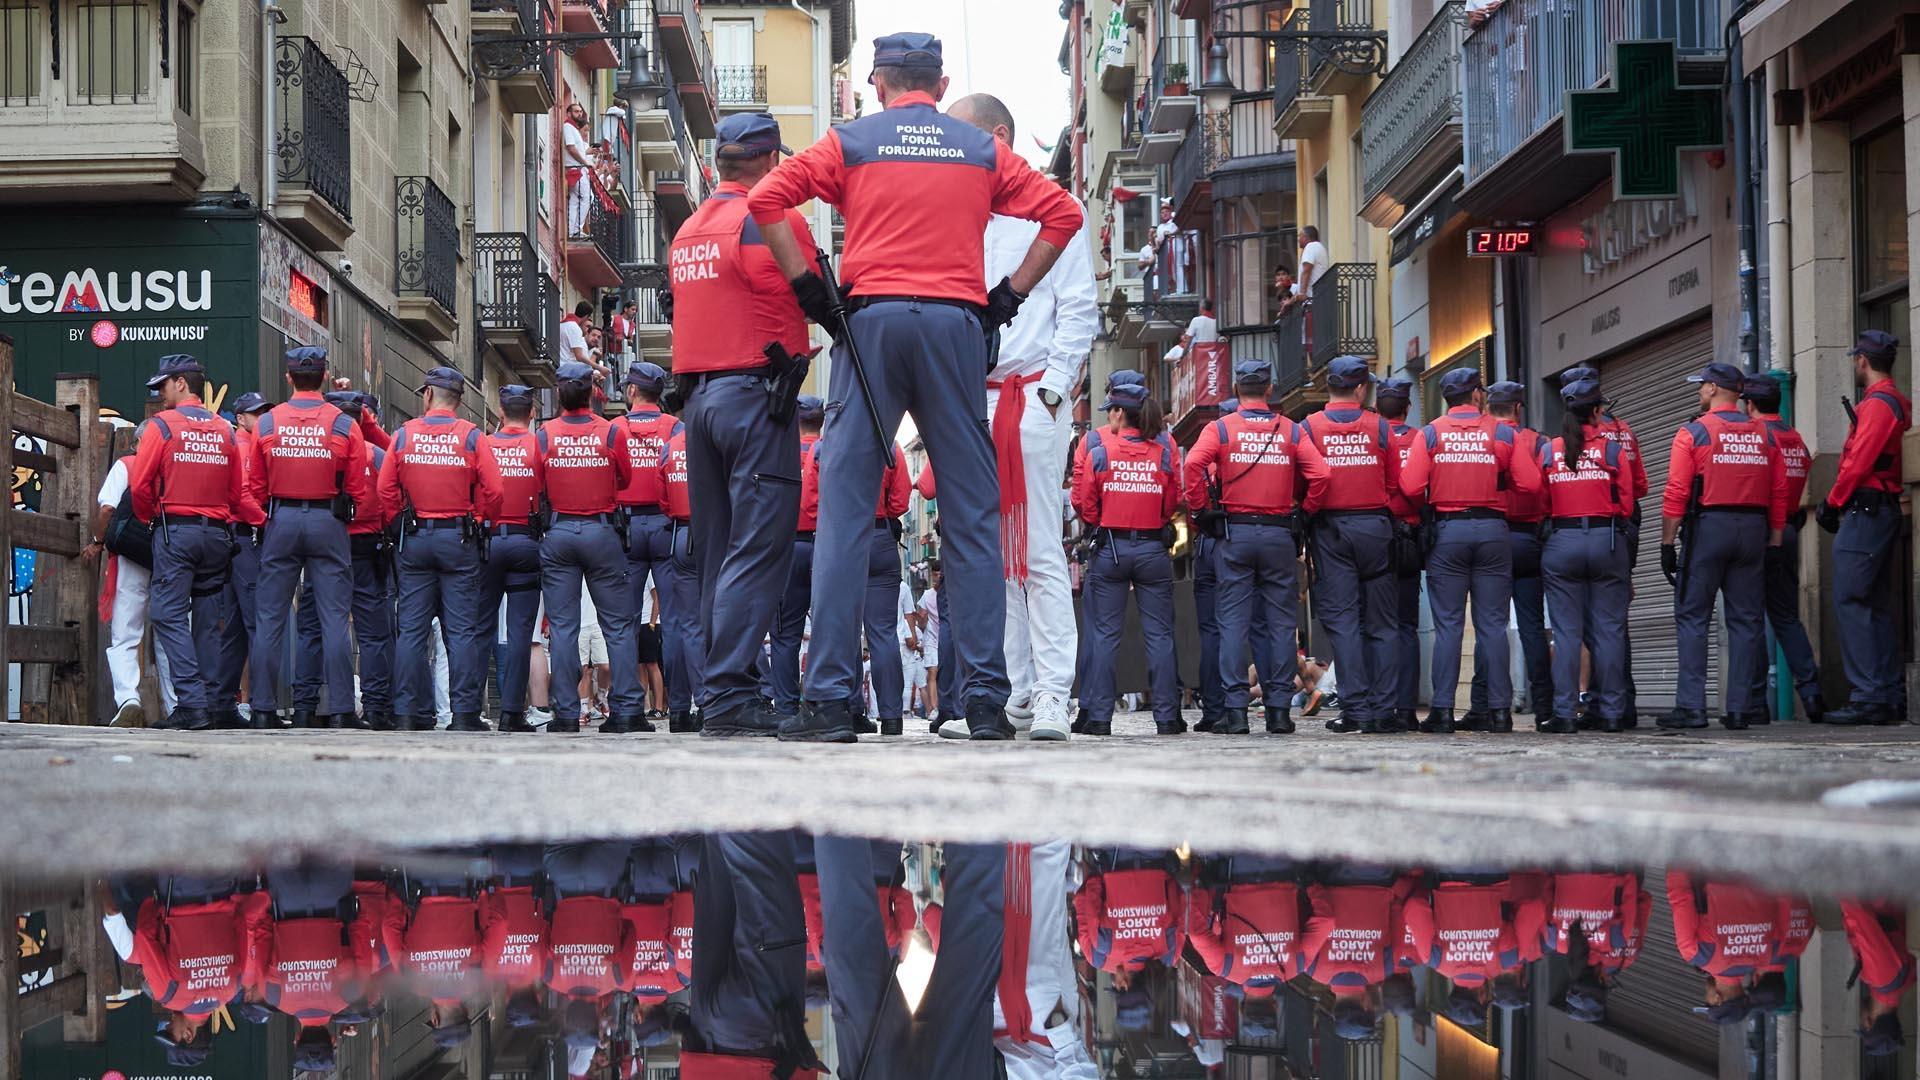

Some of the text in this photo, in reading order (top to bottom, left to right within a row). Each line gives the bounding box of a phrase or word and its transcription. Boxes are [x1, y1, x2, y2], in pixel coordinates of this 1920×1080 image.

[897, 124, 943, 135] POLICÍA
[901, 135, 941, 145] FORAL
[878, 145, 965, 158] FORUZAINGOA
[672, 240, 720, 264] POLICÍA
[673, 262, 719, 284] FORAL
[69, 328, 84, 341] BY
[1207, 359, 1217, 396] AMBAR
[181, 430, 224, 443] POLICÍA
[278, 425, 325, 437] POLICÍA
[1441, 429, 1489, 442] POLICÍA
[281, 436, 323, 447] FORAL
[413, 433, 459, 445] POLICÍA
[554, 433, 601, 447] POLICÍA
[627, 436, 665, 447] OLICÍA
[1323, 431, 1370, 445] POLICÍA
[1719, 431, 1763, 444] POLICÍA
[184, 441, 222, 454] FORAL
[415, 443, 456, 455] FORAL
[491, 445, 527, 457] OLICÍA
[558, 446, 600, 457] FORAL
[1241, 442, 1282, 454] FORAL
[1327, 445, 1368, 456] FORAL
[1444, 441, 1487, 452] FORAL
[1723, 443, 1761, 454] FORAL
[173, 452, 229, 465] FORUZAINGOA
[271, 447, 332, 460] FORUZAINGOA
[1230, 453, 1290, 465] FORUZAINGOA
[1434, 453, 1496, 465] FORUZAINGOA
[404, 454, 466, 467] FORUZAINGOA
[549, 457, 609, 469] FORUZAINGOA
[1110, 459, 1157, 472] POLICÍA
[1113, 471, 1155, 482] FORAL
[1103, 482, 1163, 495] FORUZAINGOA
